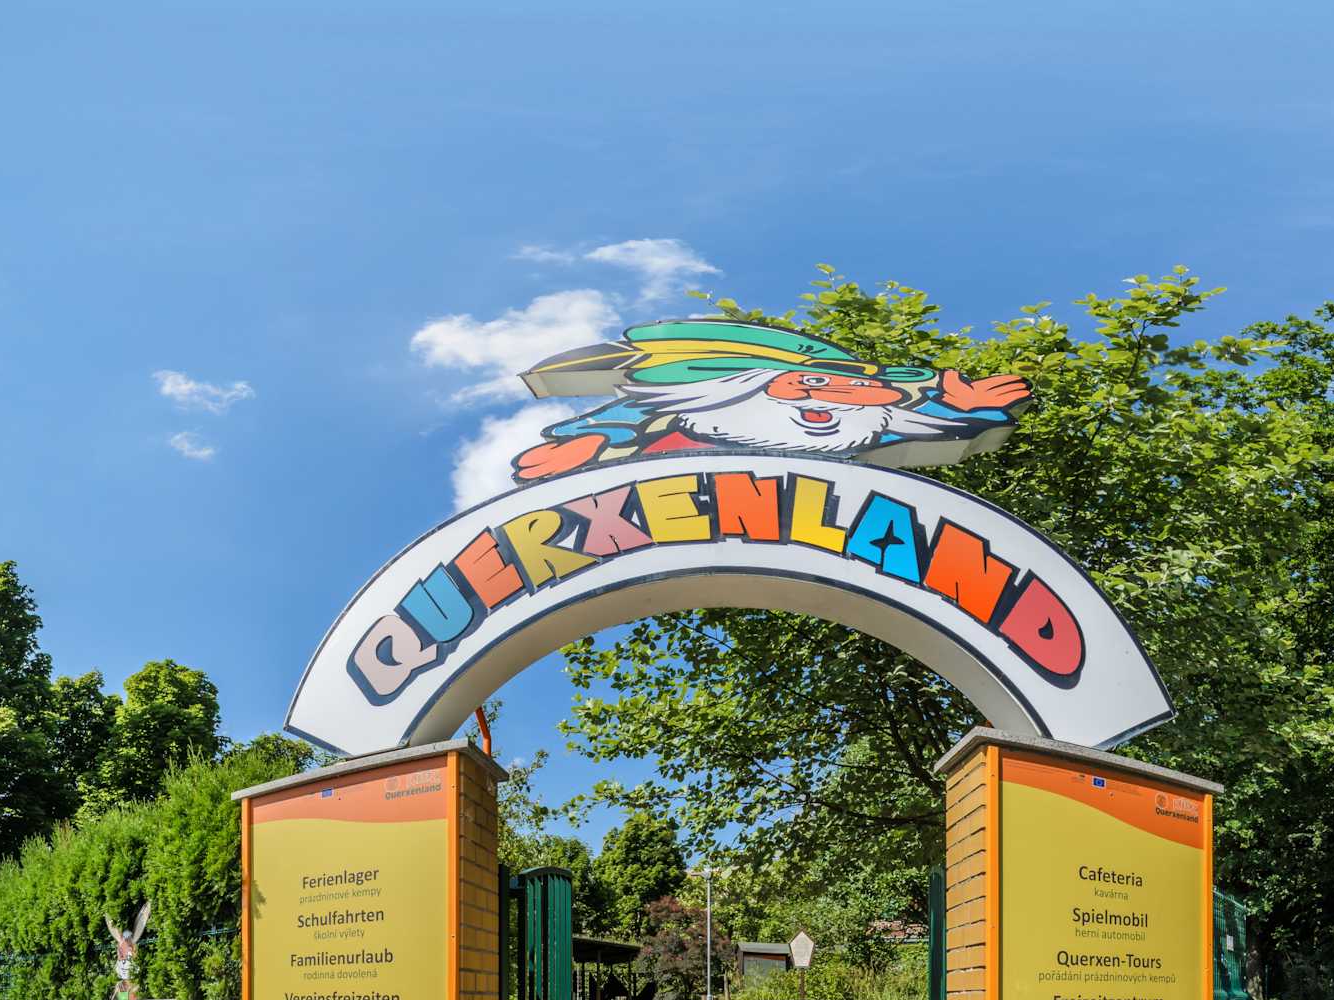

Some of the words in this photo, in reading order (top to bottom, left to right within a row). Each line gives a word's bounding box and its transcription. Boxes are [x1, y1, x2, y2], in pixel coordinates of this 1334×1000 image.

[346, 472, 1085, 706] QUERXENLAND
[302, 868, 379, 889] Ferienlager
[1078, 866, 1142, 887] Cafeteria
[297, 909, 384, 928] Schulfahrten
[1072, 907, 1148, 928] Spielmobil
[1101, 931, 1146, 941] automobil
[290, 949, 393, 968] Familienurlaub
[1056, 950, 1162, 968] Querxen-Tours
